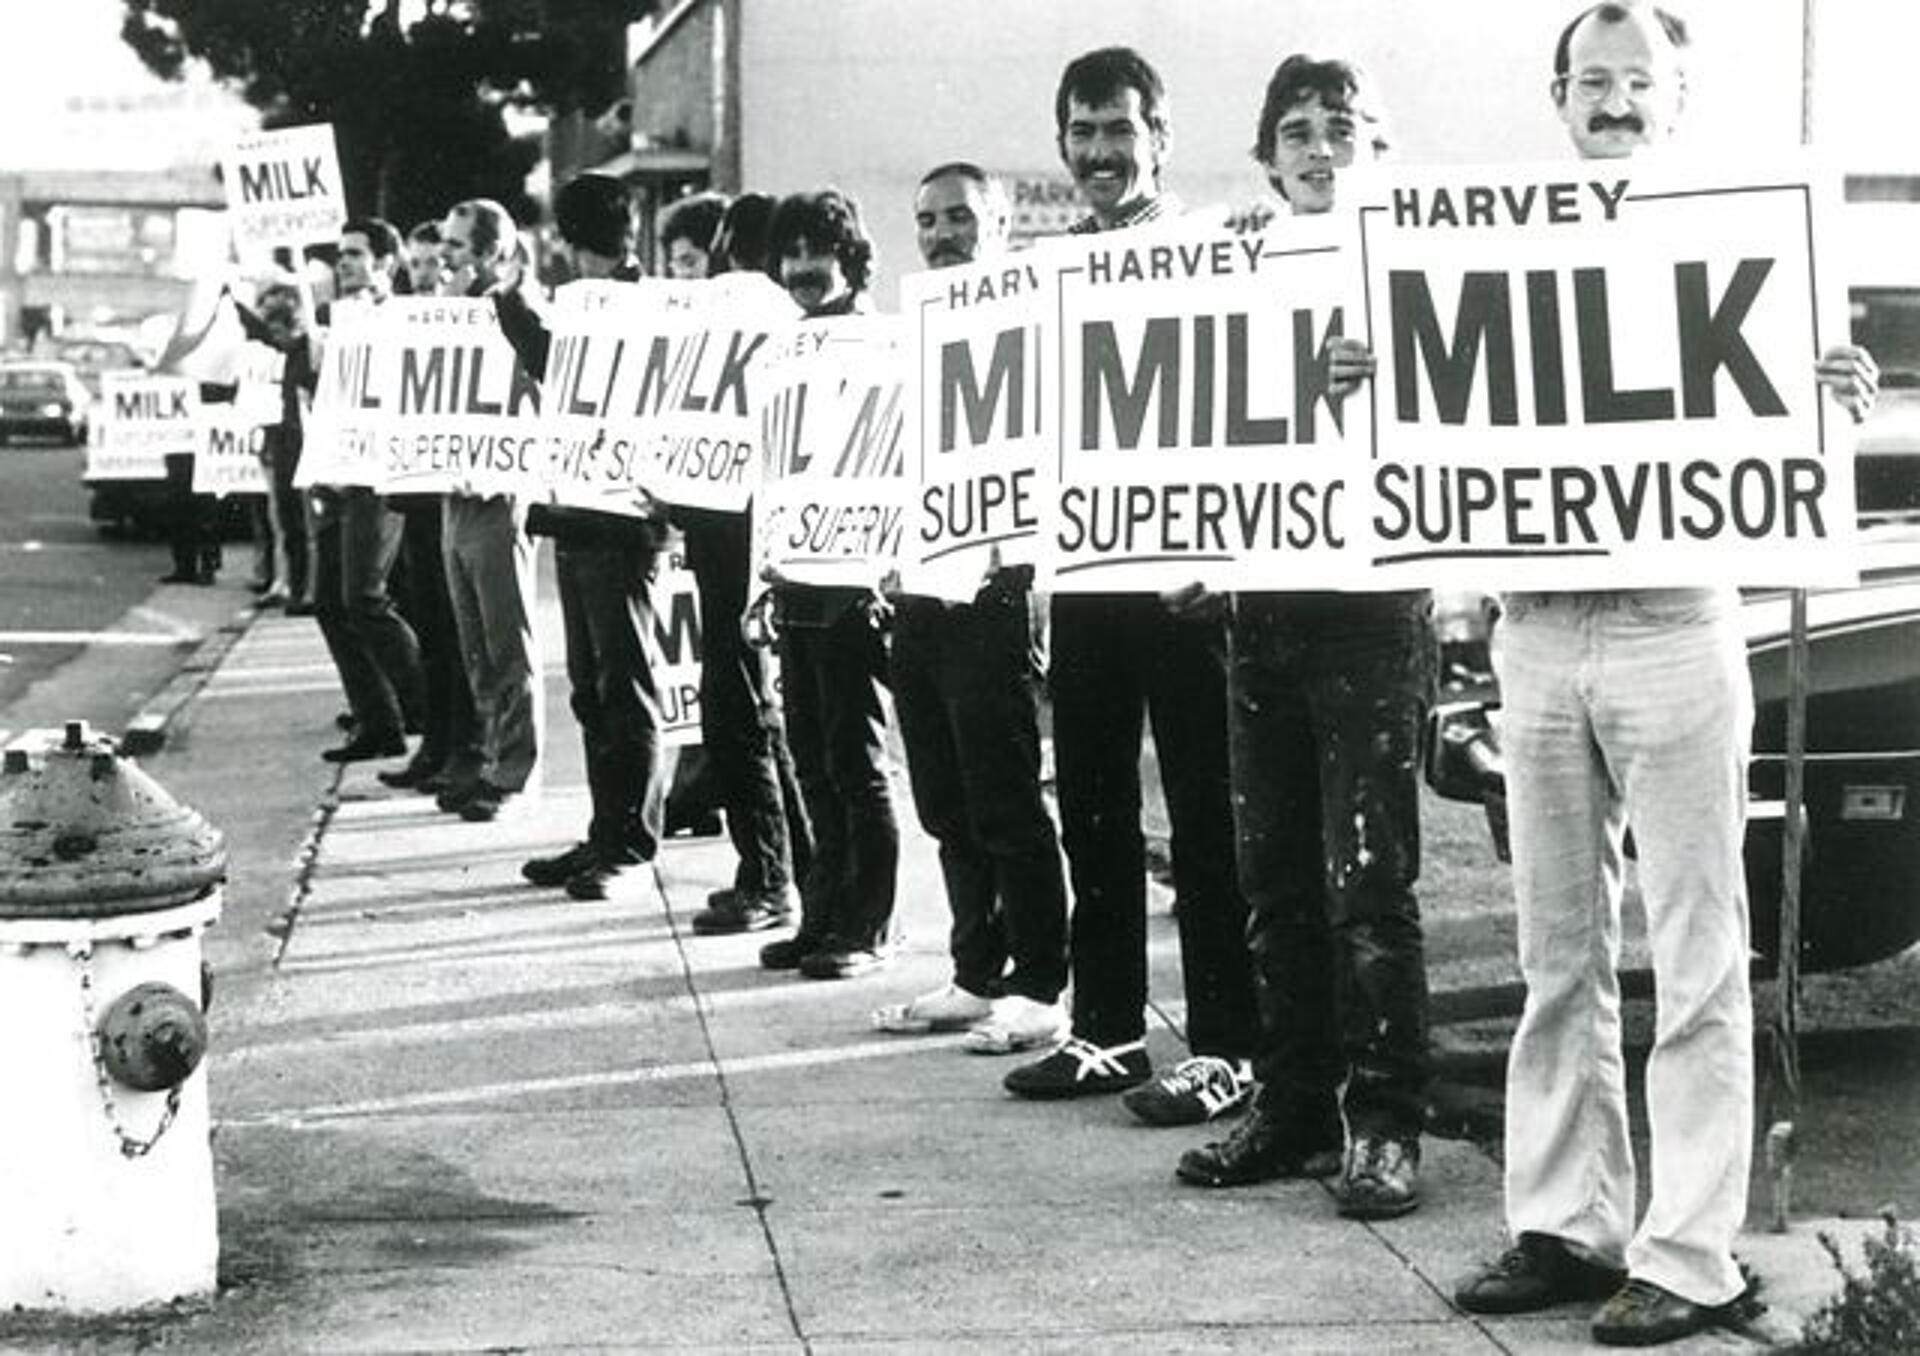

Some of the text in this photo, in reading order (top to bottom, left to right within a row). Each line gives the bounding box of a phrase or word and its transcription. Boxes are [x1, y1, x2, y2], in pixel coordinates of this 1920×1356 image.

[239, 156, 328, 203] MILK
[1393, 180, 1631, 229] HARVEY
[1088, 239, 1264, 285] HARVEY
[1388, 257, 1789, 427] MILK
[116, 389, 189, 420] MILK
[921, 467, 1039, 542] SUPE
[1372, 458, 1827, 545] SUPERVISOR
